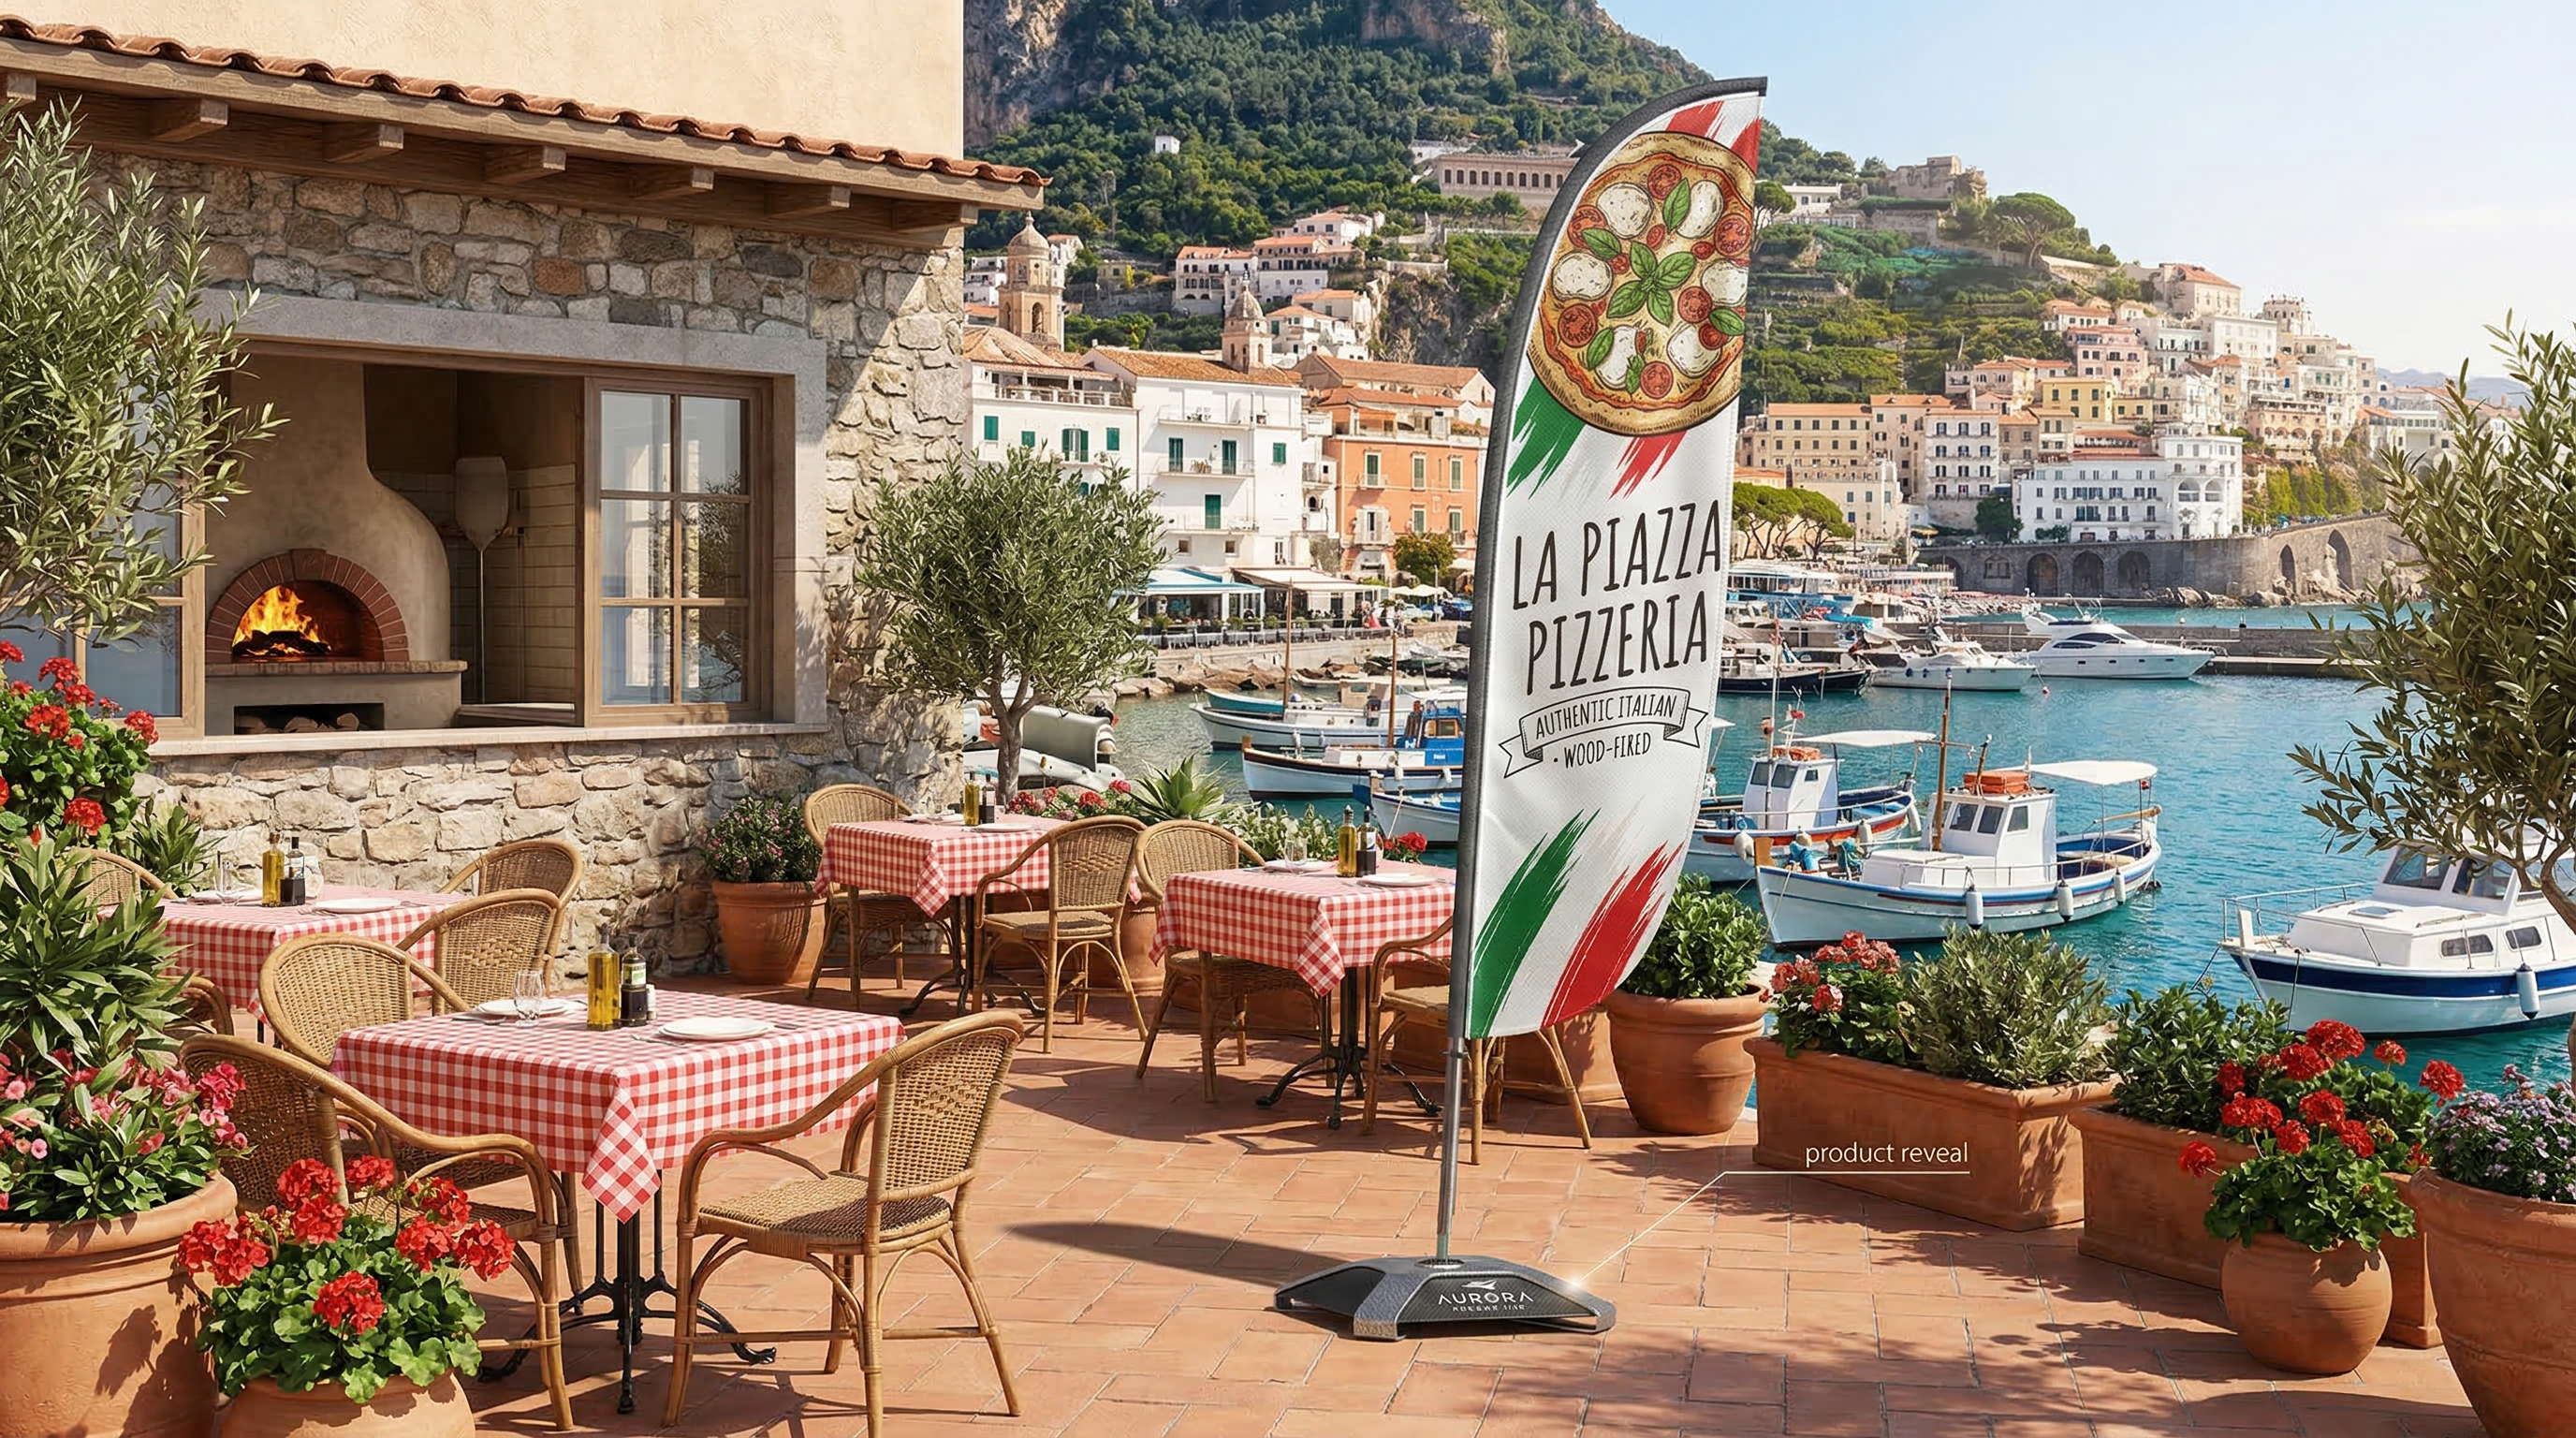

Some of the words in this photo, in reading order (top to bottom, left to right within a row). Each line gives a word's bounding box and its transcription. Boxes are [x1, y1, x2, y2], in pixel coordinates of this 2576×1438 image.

[1513, 530, 1558, 610] LA
[1581, 499, 1721, 596] PIAZZA
[1527, 590, 1707, 696] PIZZERIA
[1535, 697, 1615, 740] AUTHENTIC
[1617, 694, 1677, 719] ITALIAN
[1563, 732, 1651, 769] WOOD-FIRED
[1438, 1291, 1534, 1305] AURORA
